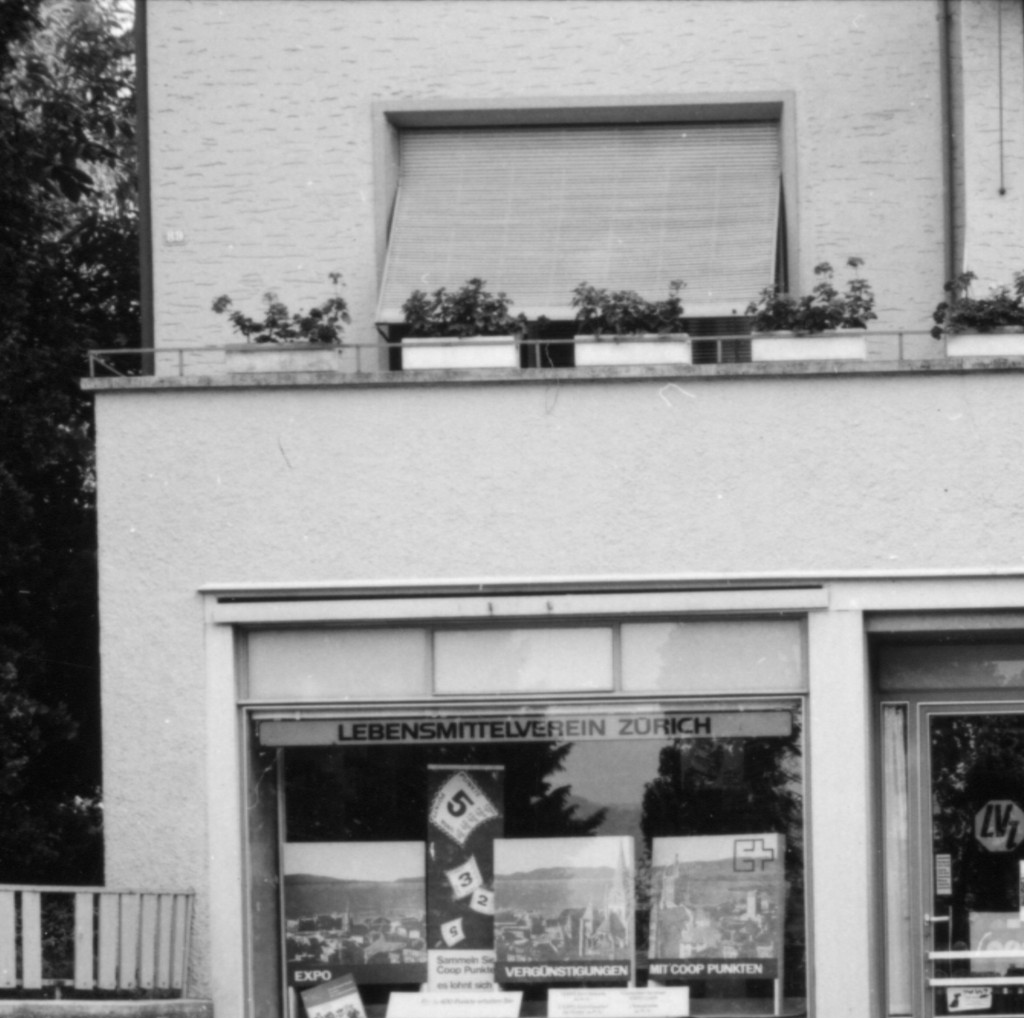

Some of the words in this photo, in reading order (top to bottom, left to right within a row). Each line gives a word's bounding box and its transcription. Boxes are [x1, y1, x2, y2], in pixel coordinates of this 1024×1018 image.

[337, 719, 606, 742] LEBENSMITTELVEREIN
[618, 716, 712, 736] ZÜRICH
[446, 789, 475, 818] 5
[458, 872, 473, 887] 3
[477, 895, 489, 907] 2
[504, 965, 629, 977] VERGÜNSTIGUNGEN
[648, 963, 668, 975] MIT
[670, 963, 705, 975] COOP
[706, 962, 763, 975] PUNKTEN
[294, 970, 332, 982] EXPO
